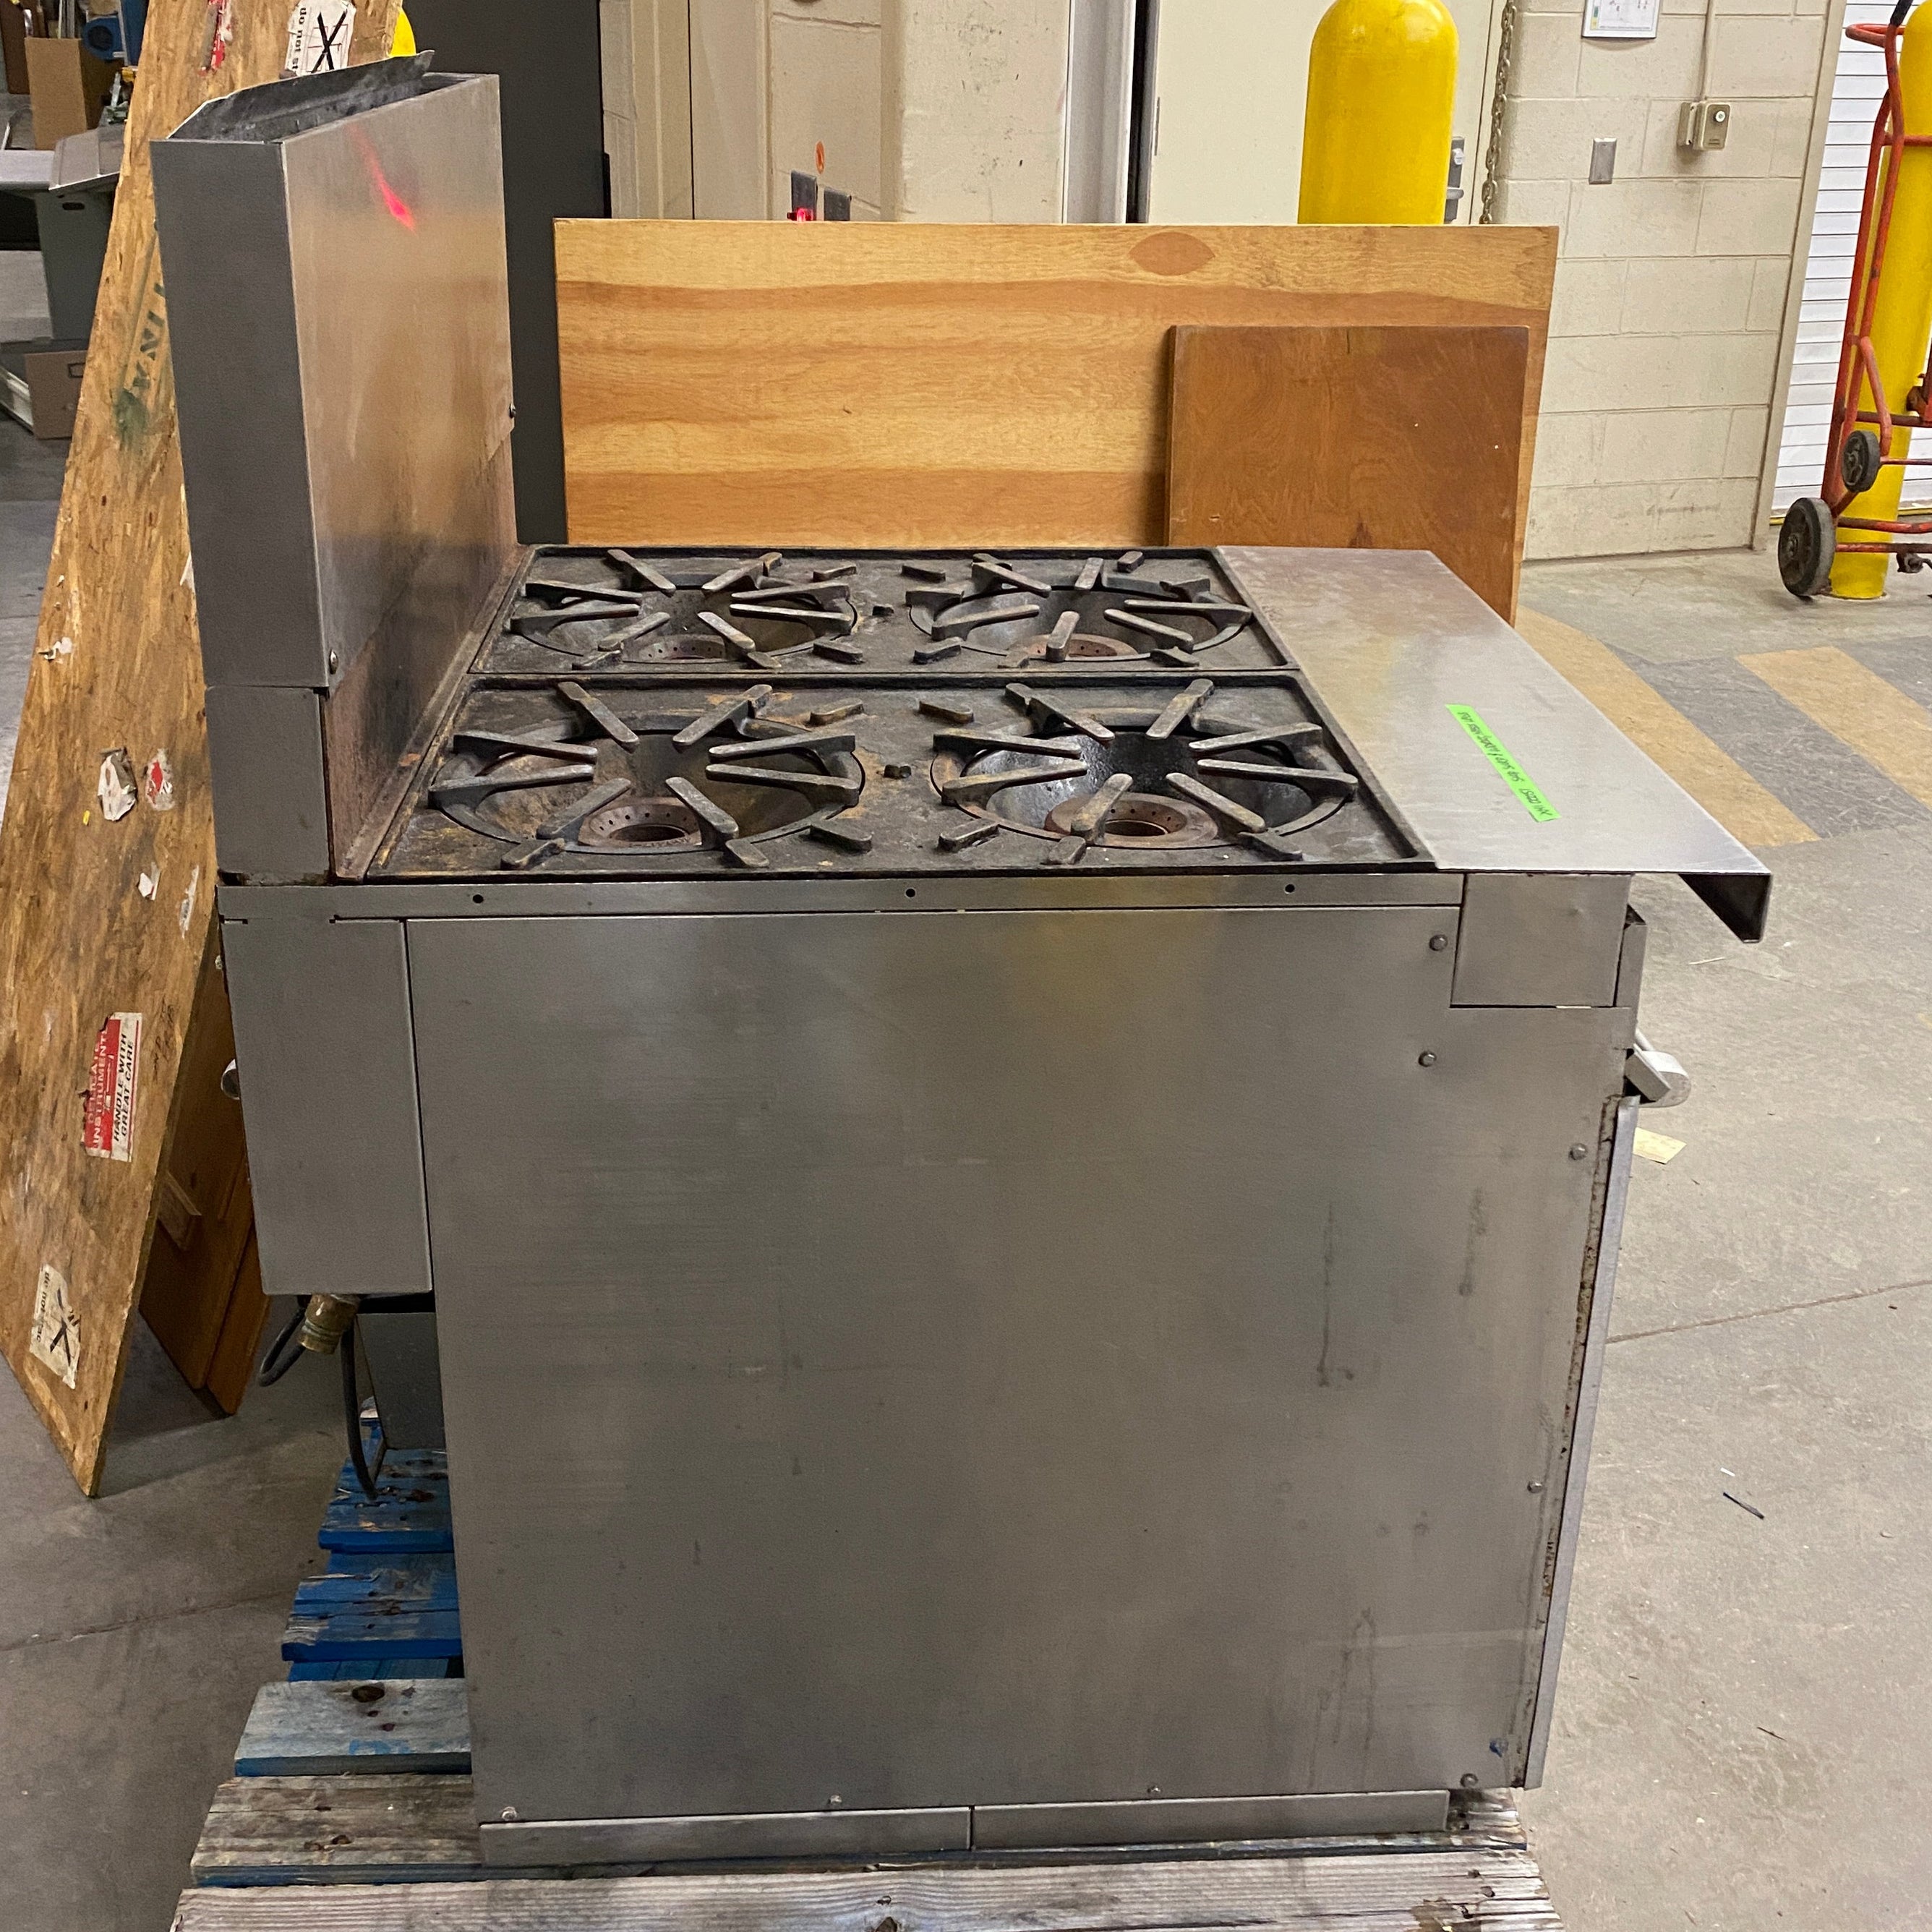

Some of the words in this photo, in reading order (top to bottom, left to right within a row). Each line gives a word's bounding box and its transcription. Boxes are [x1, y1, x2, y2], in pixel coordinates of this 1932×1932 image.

[299, 8, 307, 25] do
[118, 1033, 127, 1073] WITH
[125, 1041, 135, 1082] CARE
[114, 1080, 124, 1142] HANDLE
[121, 1088, 130, 1137] GREAT
